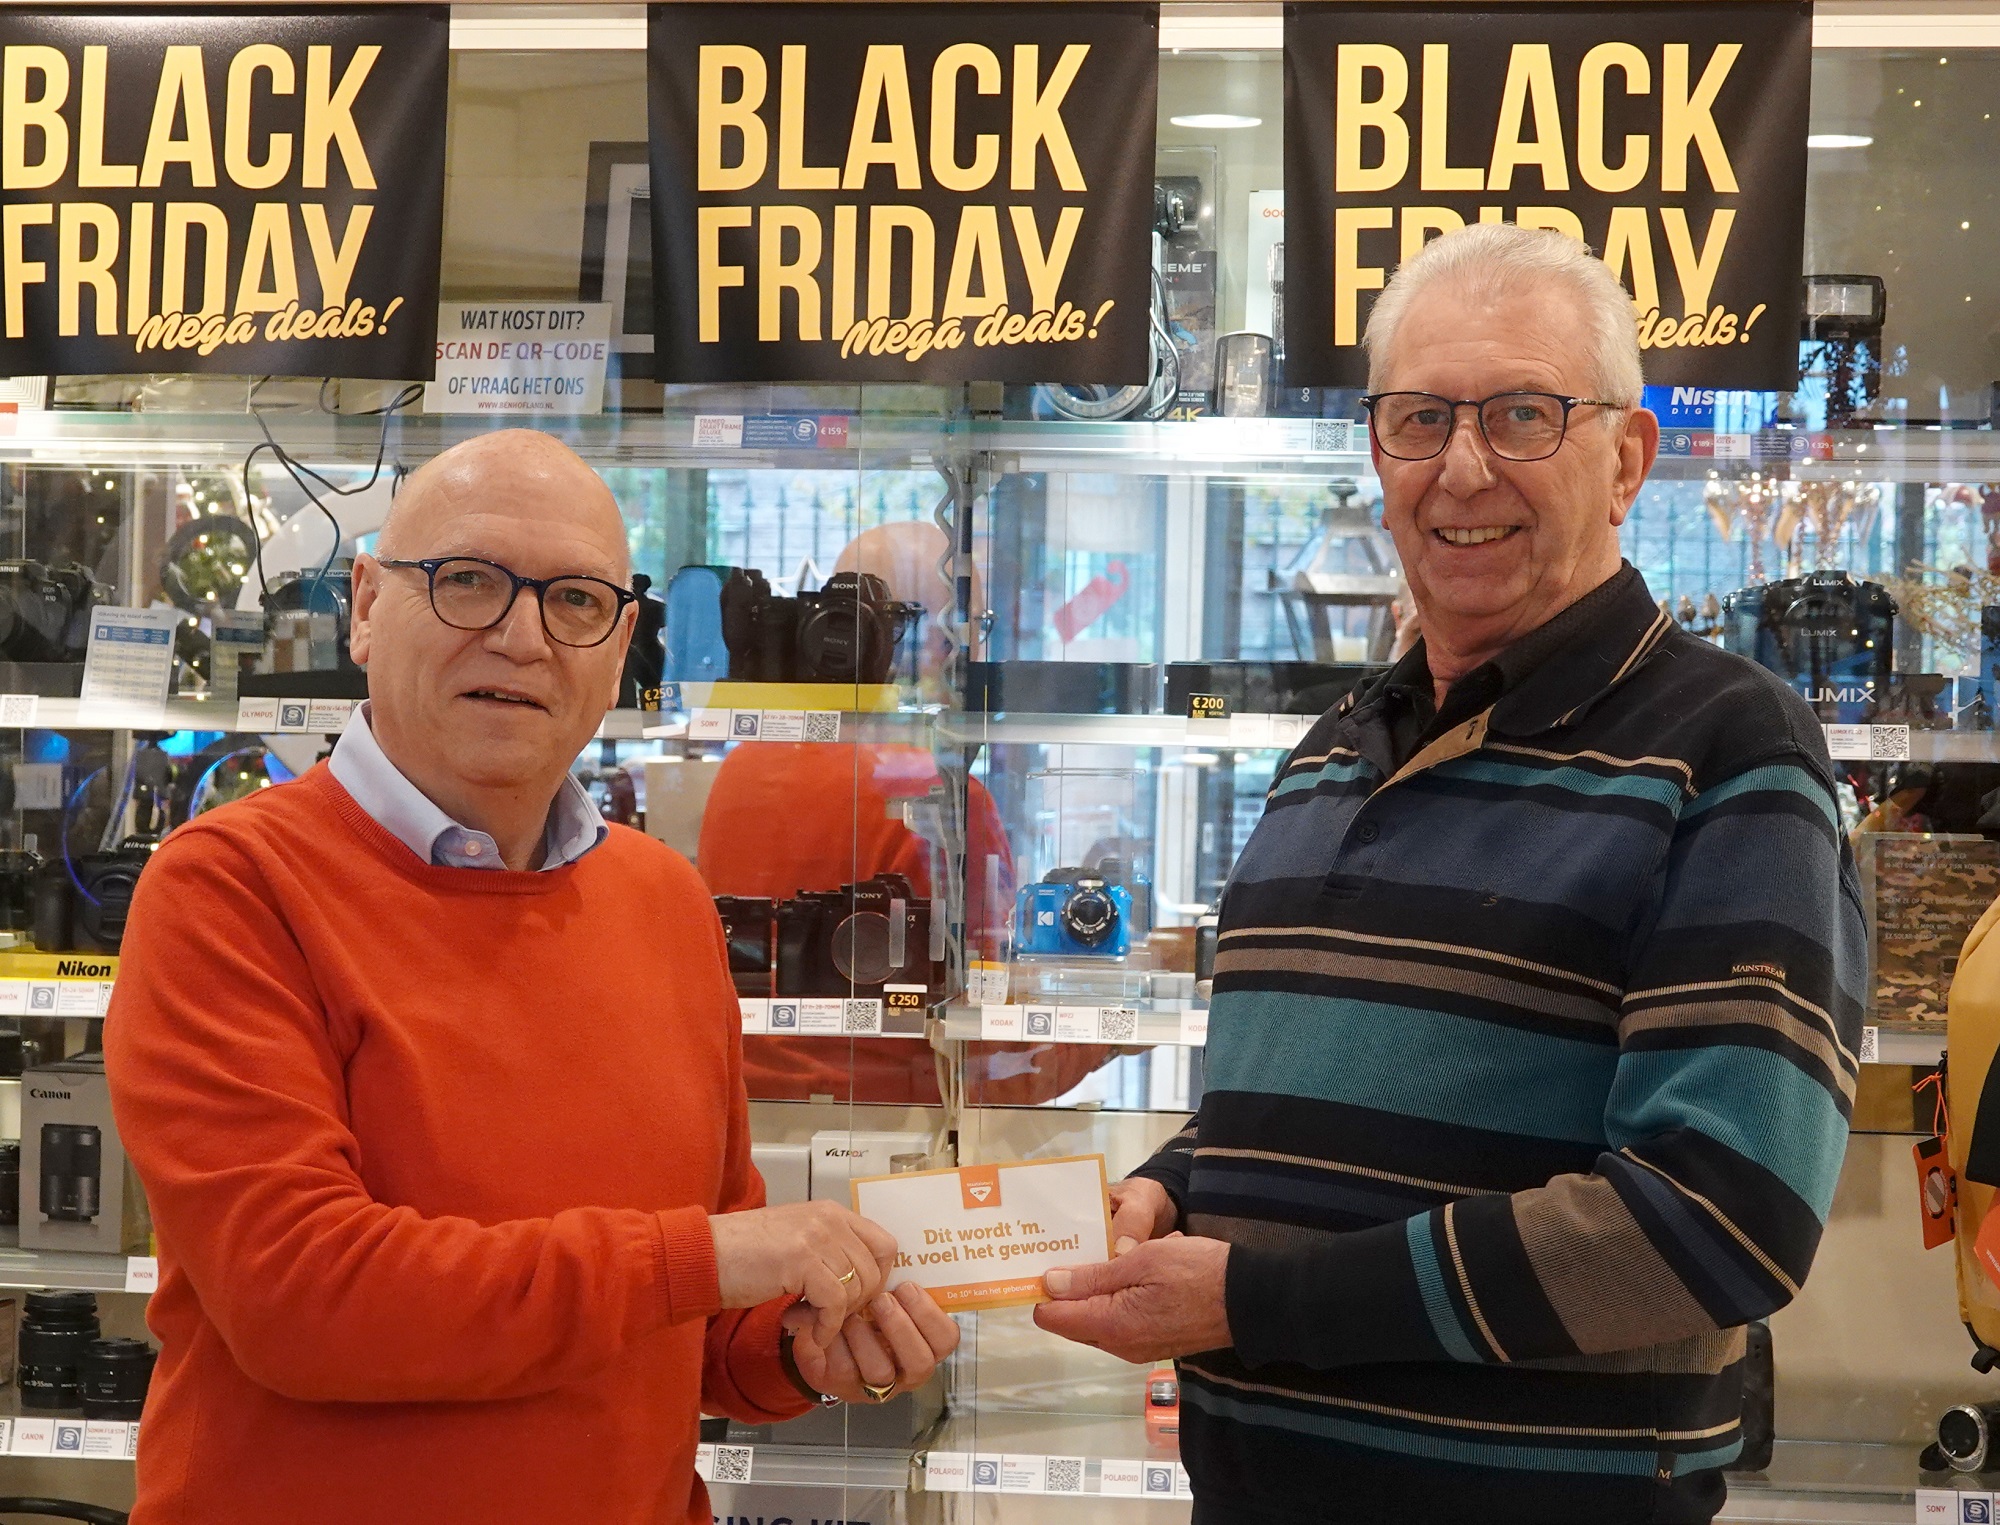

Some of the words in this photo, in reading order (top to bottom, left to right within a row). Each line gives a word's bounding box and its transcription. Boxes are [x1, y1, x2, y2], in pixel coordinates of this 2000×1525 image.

[2, 45, 381, 190] BLACK
[698, 44, 1090, 191] BLACK
[1335, 43, 1743, 192] BLACK
[4, 202, 375, 338] FRIDAY
[698, 206, 1084, 342] FRIDAY
[1334, 207, 1736, 347] FAY
[135, 309, 257, 357] Mega
[264, 297, 404, 343] deals!
[461, 310, 498, 329] WAT
[502, 310, 545, 330] KOST
[548, 310, 585, 330] DIT?
[840, 316, 966, 363] Mega
[975, 299, 1115, 347] deals!
[436, 342, 482, 360] SCAN
[487, 342, 512, 360] DE
[516, 343, 605, 360] QR-CODE
[448, 376, 468, 395] OF
[471, 376, 519, 395] VRAAG
[523, 377, 551, 395] HET
[554, 377, 585, 395] ONS
[1671, 386, 1752, 406] Nissin
[477, 401, 554, 409] WWW.BENHOFLAND.NL
[1166, 406, 1205, 422] 4K
[831, 582, 860, 590] SONY
[1813, 578, 1844, 586] LUMIX
[1801, 628, 1837, 637] LUMIX
[1804, 687, 1877, 703] UMIX
[700, 720, 719, 728] SONY
[123, 841, 151, 850] Nikon
[57, 961, 111, 977] Nikon
[1731, 964, 1786, 981] MAINSTREAM
[742, 1012, 756, 1020] ONY
[30, 1088, 71, 1100] Canon
[924, 1228, 952, 1245] Dit
[957, 1221, 1012, 1242] wordt
[893, 1252, 912, 1268] Ik
[917, 1246, 959, 1266] voel
[963, 1243, 994, 1261] het
[998, 1233, 1080, 1261] gewoon!
[947, 1291, 958, 1299] De
[973, 1288, 988, 1297] kan
[989, 1286, 1001, 1295] het
[21, 1432, 44, 1441] CANON
[928, 1466, 965, 1475] POLAROID
[1103, 1474, 1139, 1482] POLAROID
[1658, 1468, 1671, 1479] M
[1926, 1505, 1946, 1513] SONY
